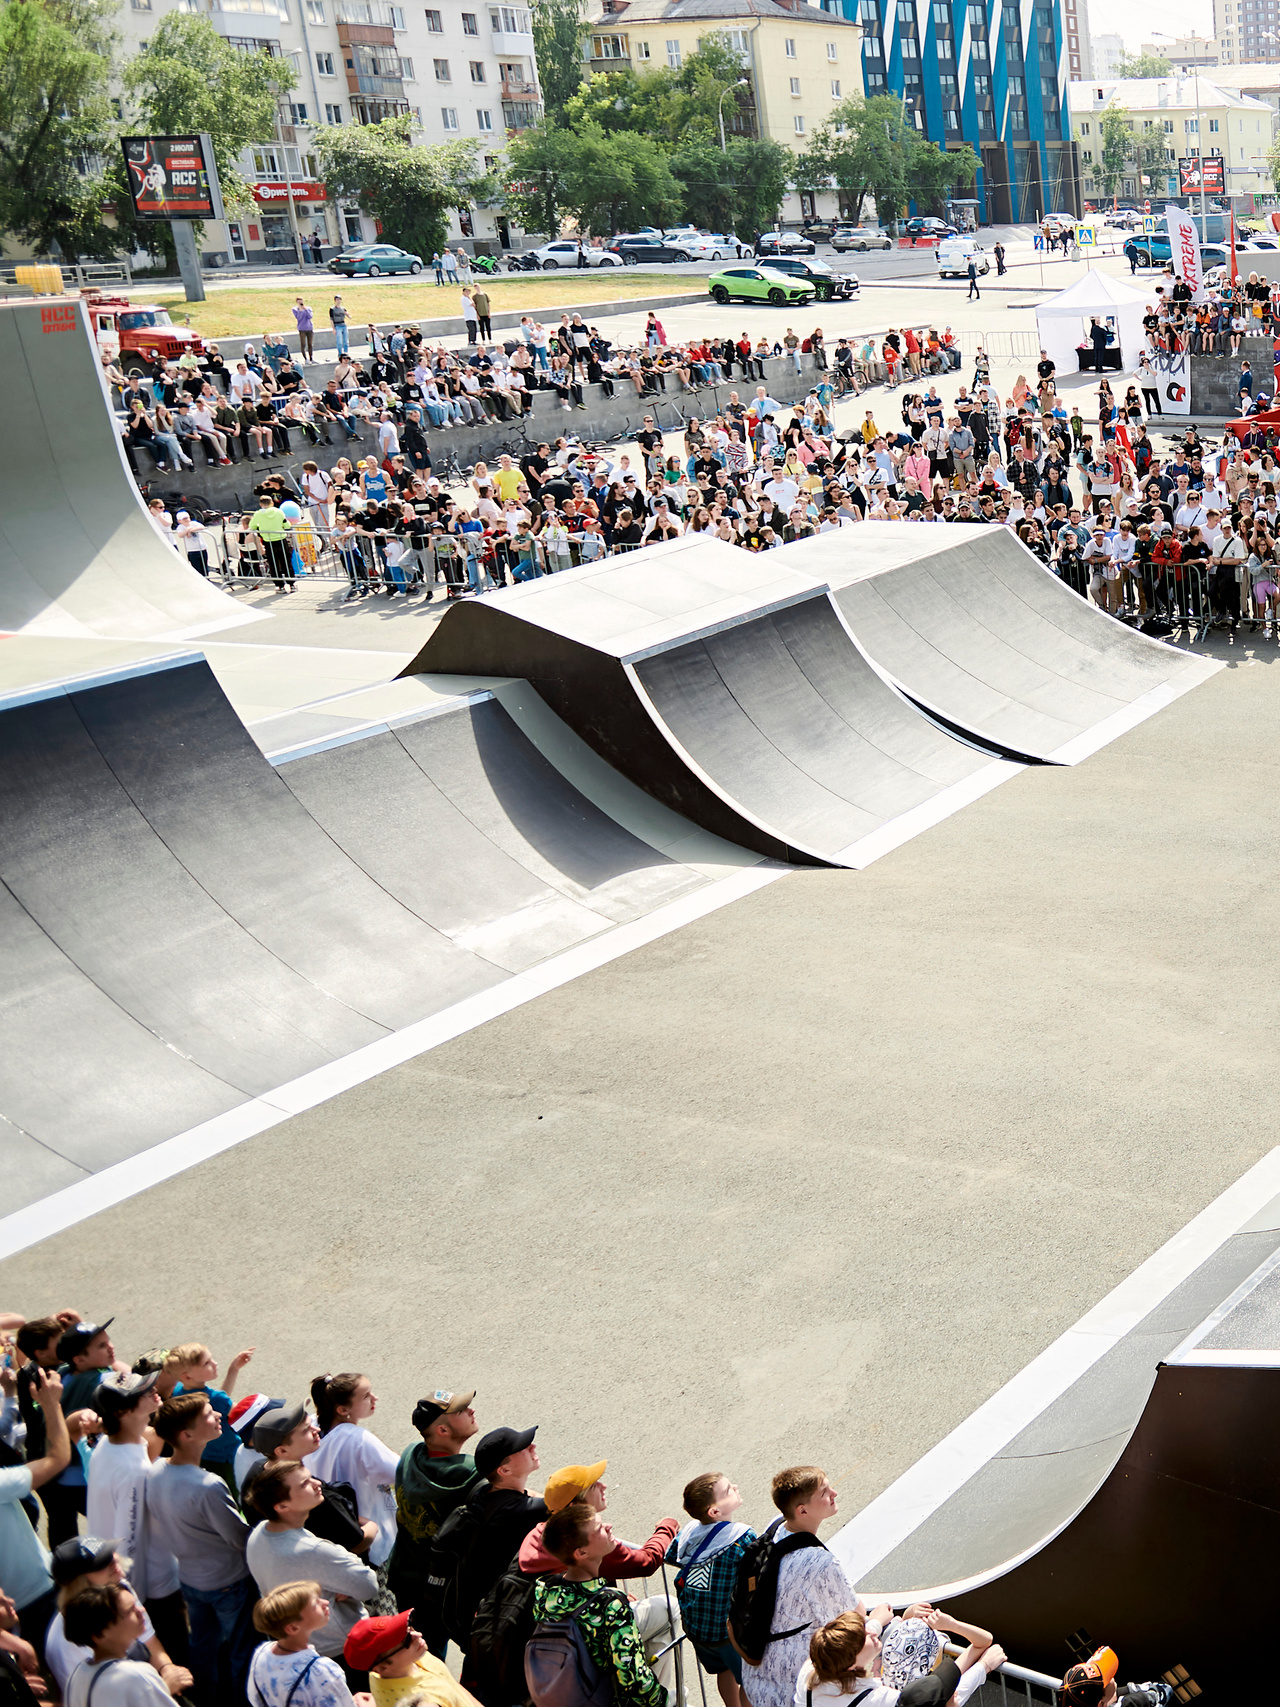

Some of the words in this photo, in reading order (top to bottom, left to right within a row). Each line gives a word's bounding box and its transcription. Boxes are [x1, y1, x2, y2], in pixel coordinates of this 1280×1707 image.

[171, 171, 197, 186] RCC
[260, 186, 309, 199] Брисоль
[40, 306, 75, 322] RCC
